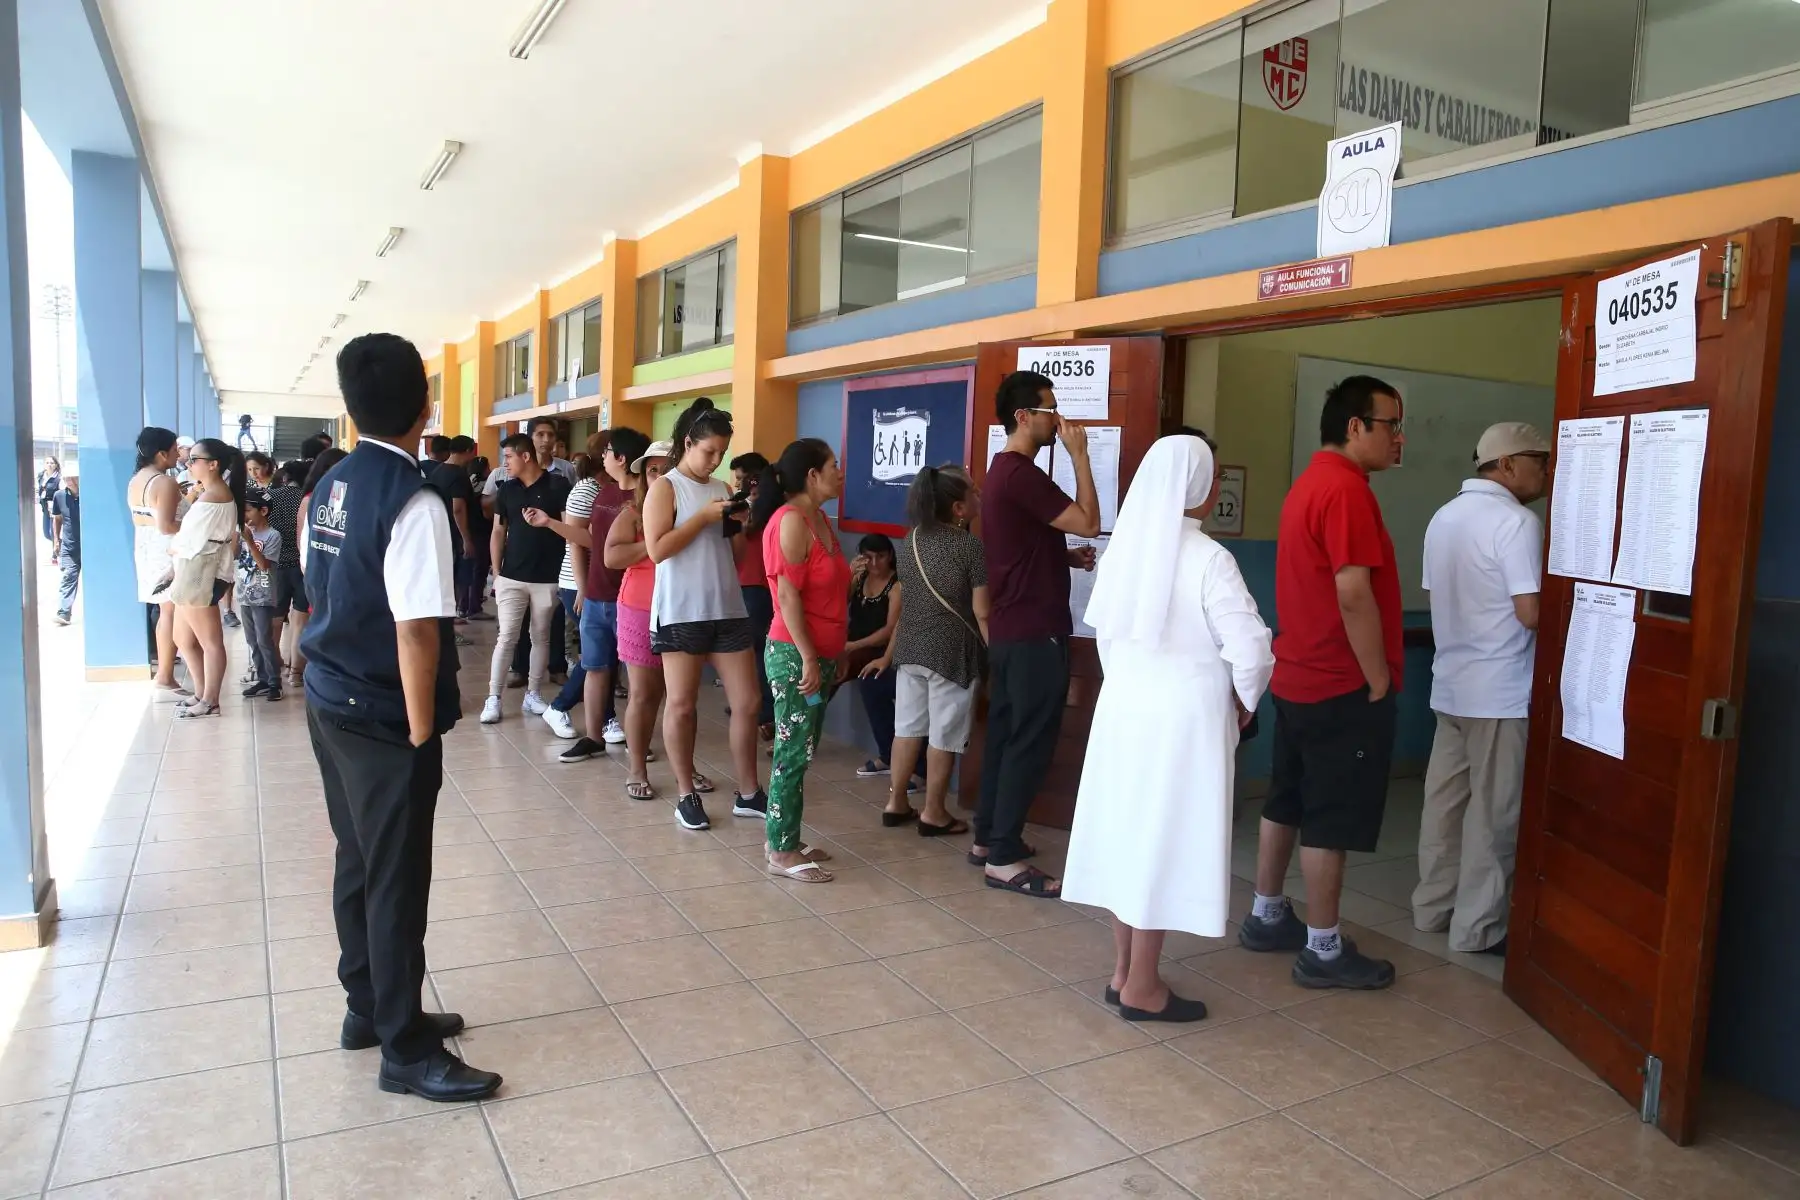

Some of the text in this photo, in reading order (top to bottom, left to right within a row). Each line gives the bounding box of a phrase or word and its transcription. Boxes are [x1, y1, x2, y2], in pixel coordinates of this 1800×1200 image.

[1339, 61, 1367, 115] LAS
[1369, 71, 1421, 130] DAMAS
[1424, 88, 1435, 134] Y
[1436, 92, 1521, 146] CABALLEROS
[1341, 137, 1385, 159] AULA
[1333, 178, 1372, 220] 501
[1277, 263, 1347, 284] AULA FUNCIONAL 1
[1279, 275, 1332, 293] COMUNICACIÓN
[1632, 275, 1641, 286] DE
[1642, 270, 1661, 283] MESA
[1609, 281, 1678, 325] 040535
[1031, 360, 1095, 377] 040536
[316, 504, 347, 531] ONPE
[1217, 502, 1234, 517] 12
